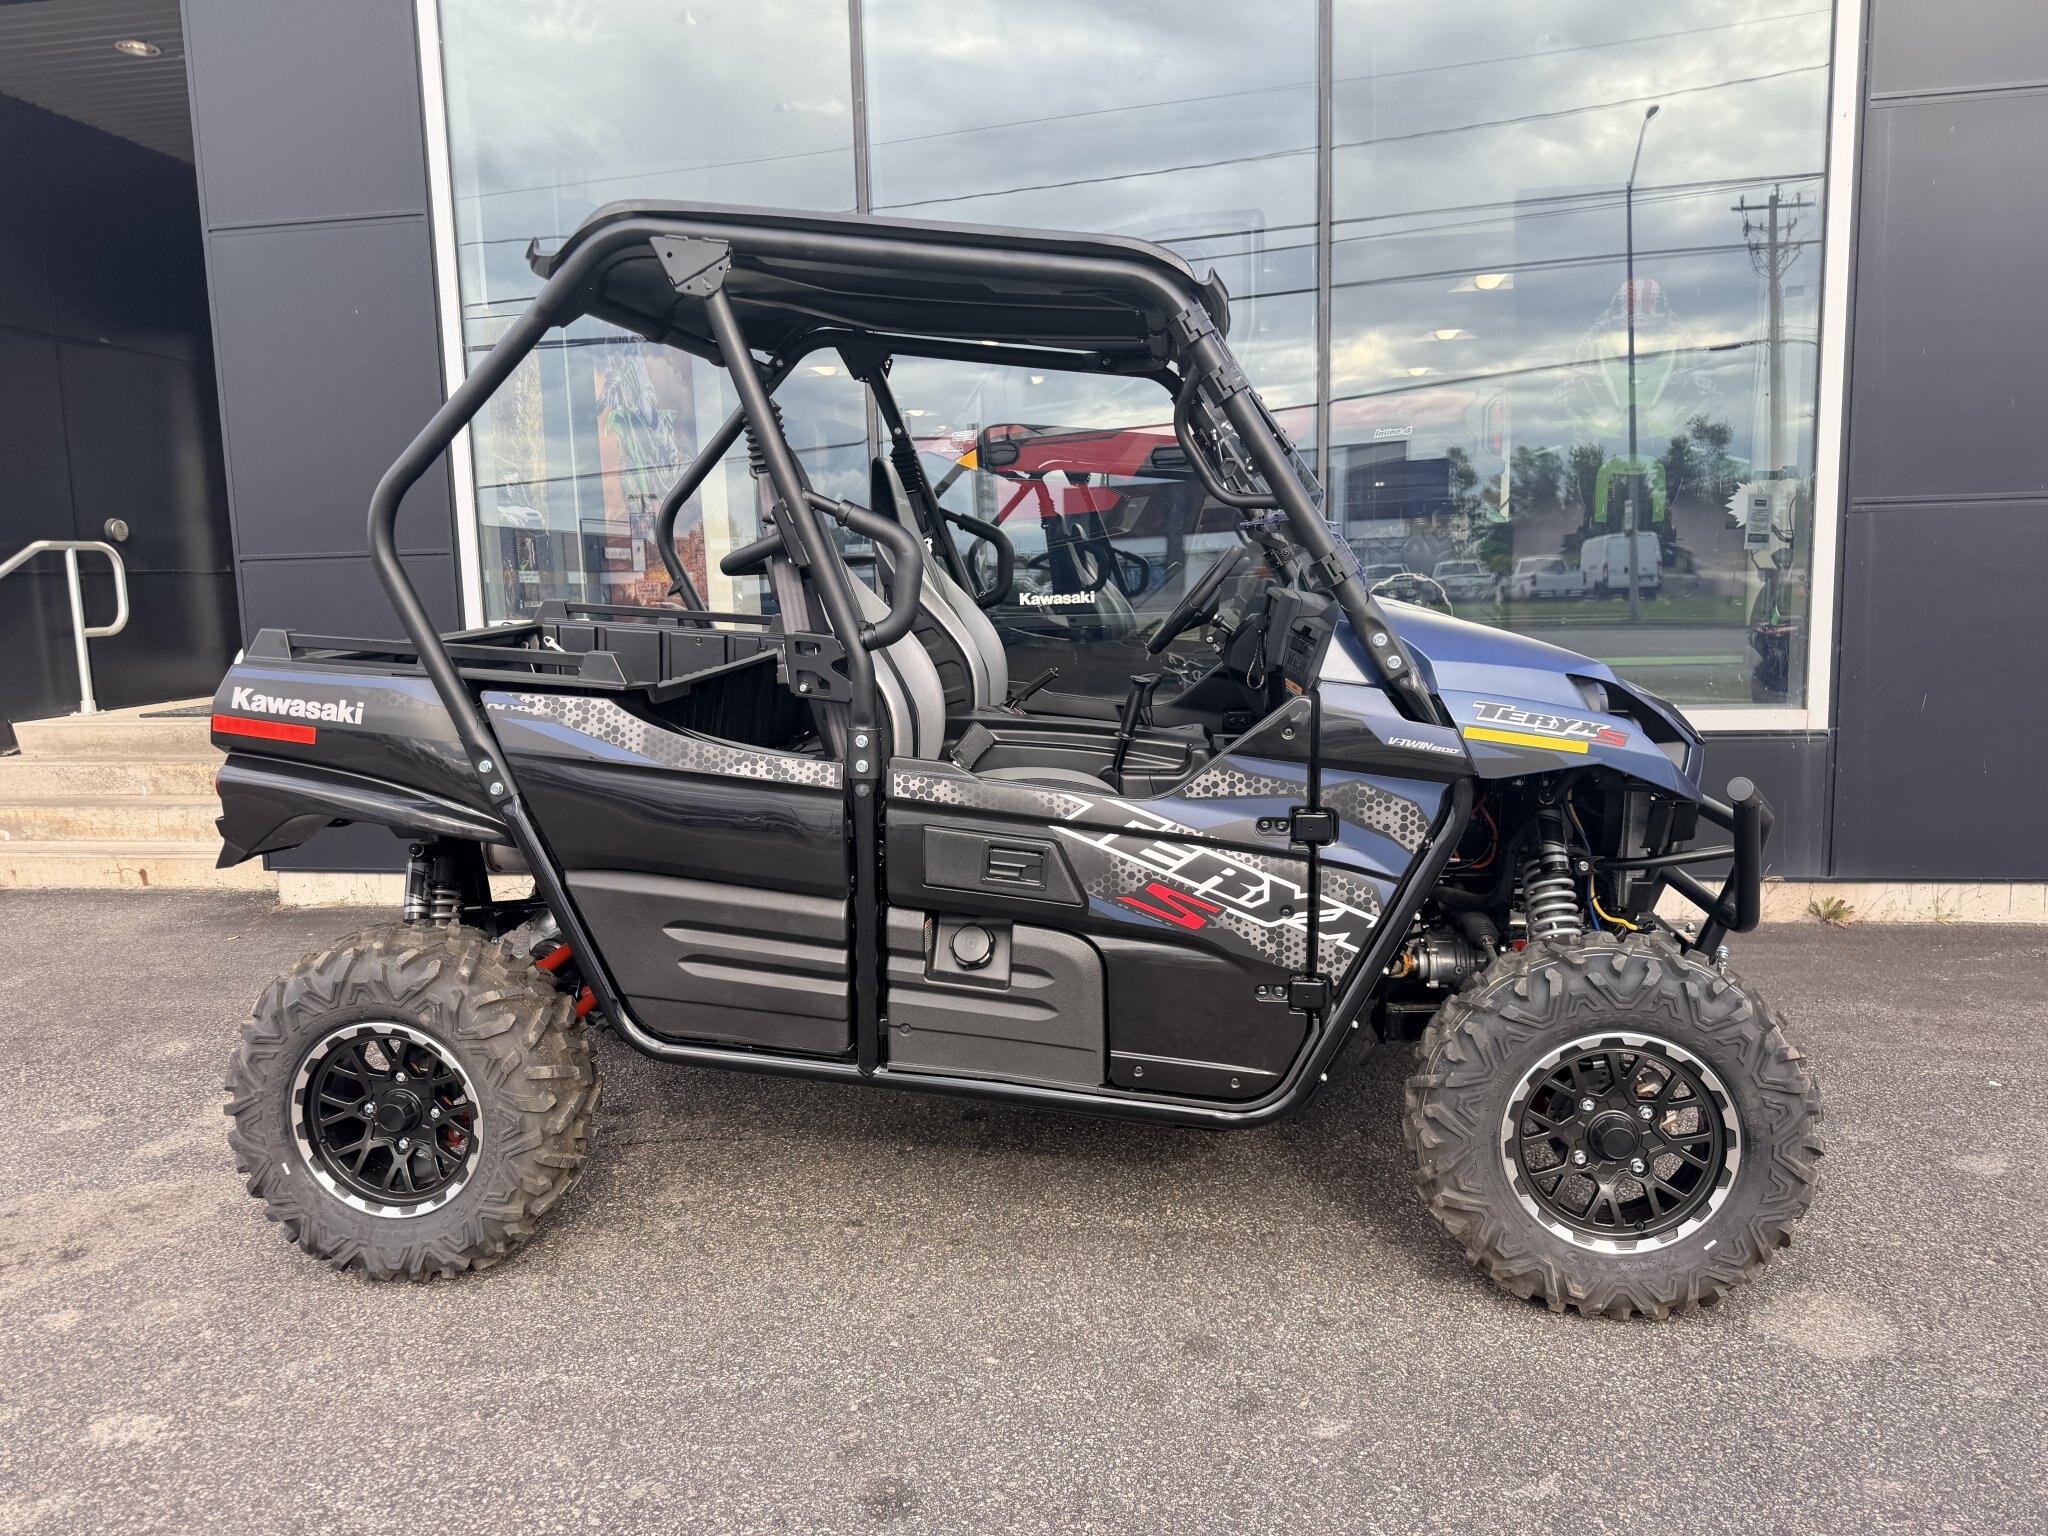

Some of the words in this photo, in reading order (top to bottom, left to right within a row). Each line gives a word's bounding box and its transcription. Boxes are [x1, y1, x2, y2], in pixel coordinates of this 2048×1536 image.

[1018, 590, 1096, 606] Kawasaki
[231, 686, 365, 725] Kawasaki
[1472, 700, 1613, 738] TERYX
[1590, 729, 1629, 746] S
[1048, 793, 1379, 953] TERYX
[1115, 882, 1222, 930] S
